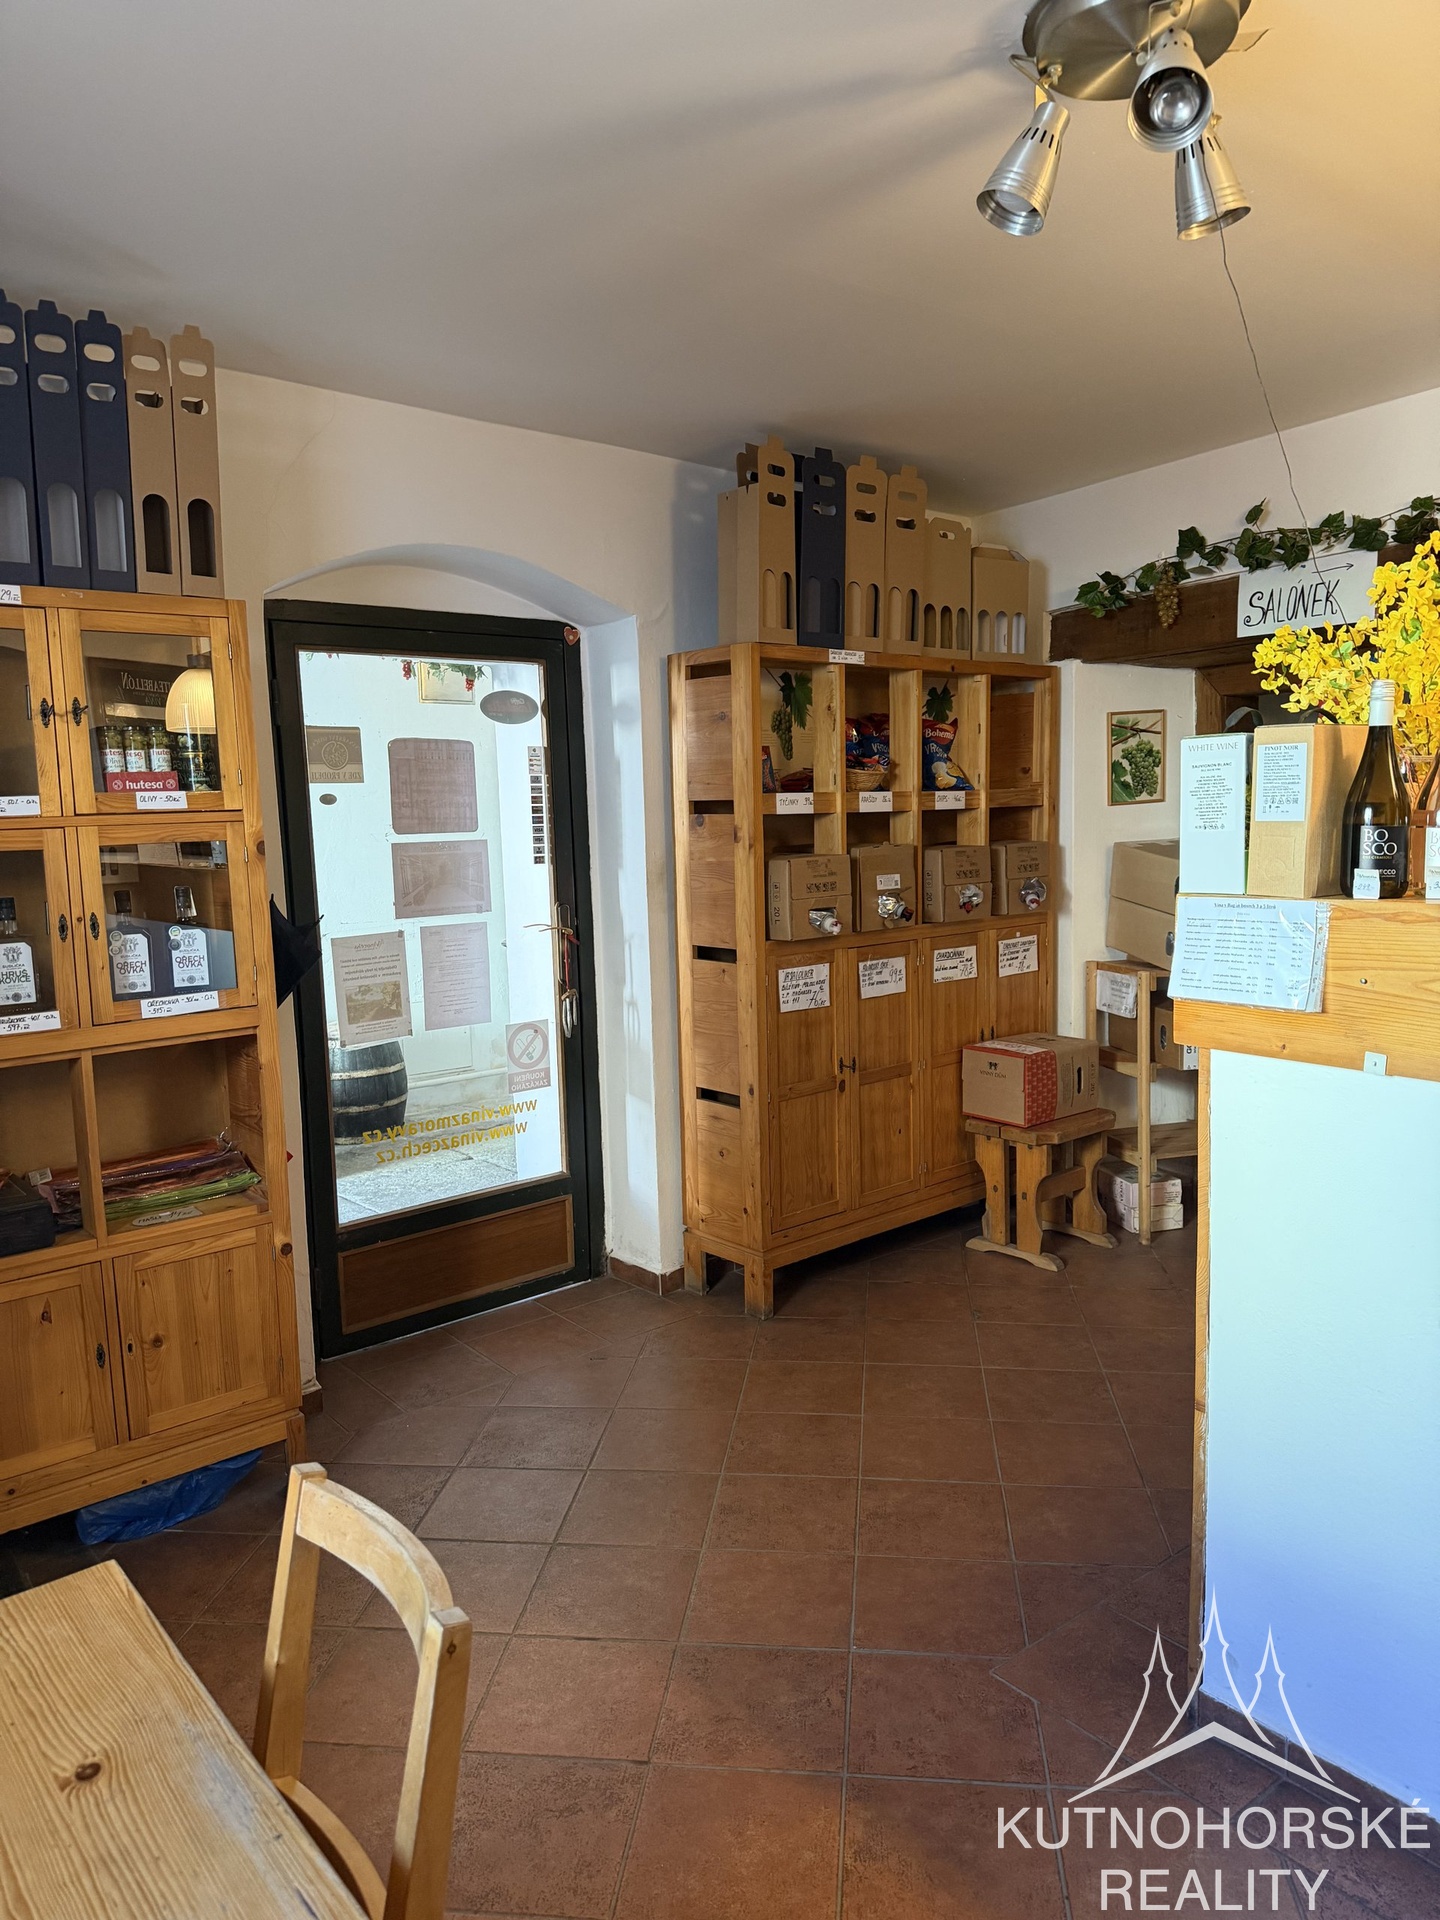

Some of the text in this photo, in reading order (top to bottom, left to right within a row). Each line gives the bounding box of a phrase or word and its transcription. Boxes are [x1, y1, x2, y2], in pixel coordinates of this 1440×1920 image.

[1243, 578, 1341, 627] SALÓNEK
[1188, 742, 1239, 752] WHITE WINE
[125, 779, 164, 790] hutesa
[1363, 828, 1389, 843] BO
[1362, 842, 1398, 856] SCO
[773, 906, 781, 918] 20
[116, 959, 147, 971] OŘECH
[174, 954, 205, 965] OŘECH
[177, 960, 204, 969] OVKA
[0, 968, 28, 979] HRUŠ
[119, 966, 146, 975] OVKA
